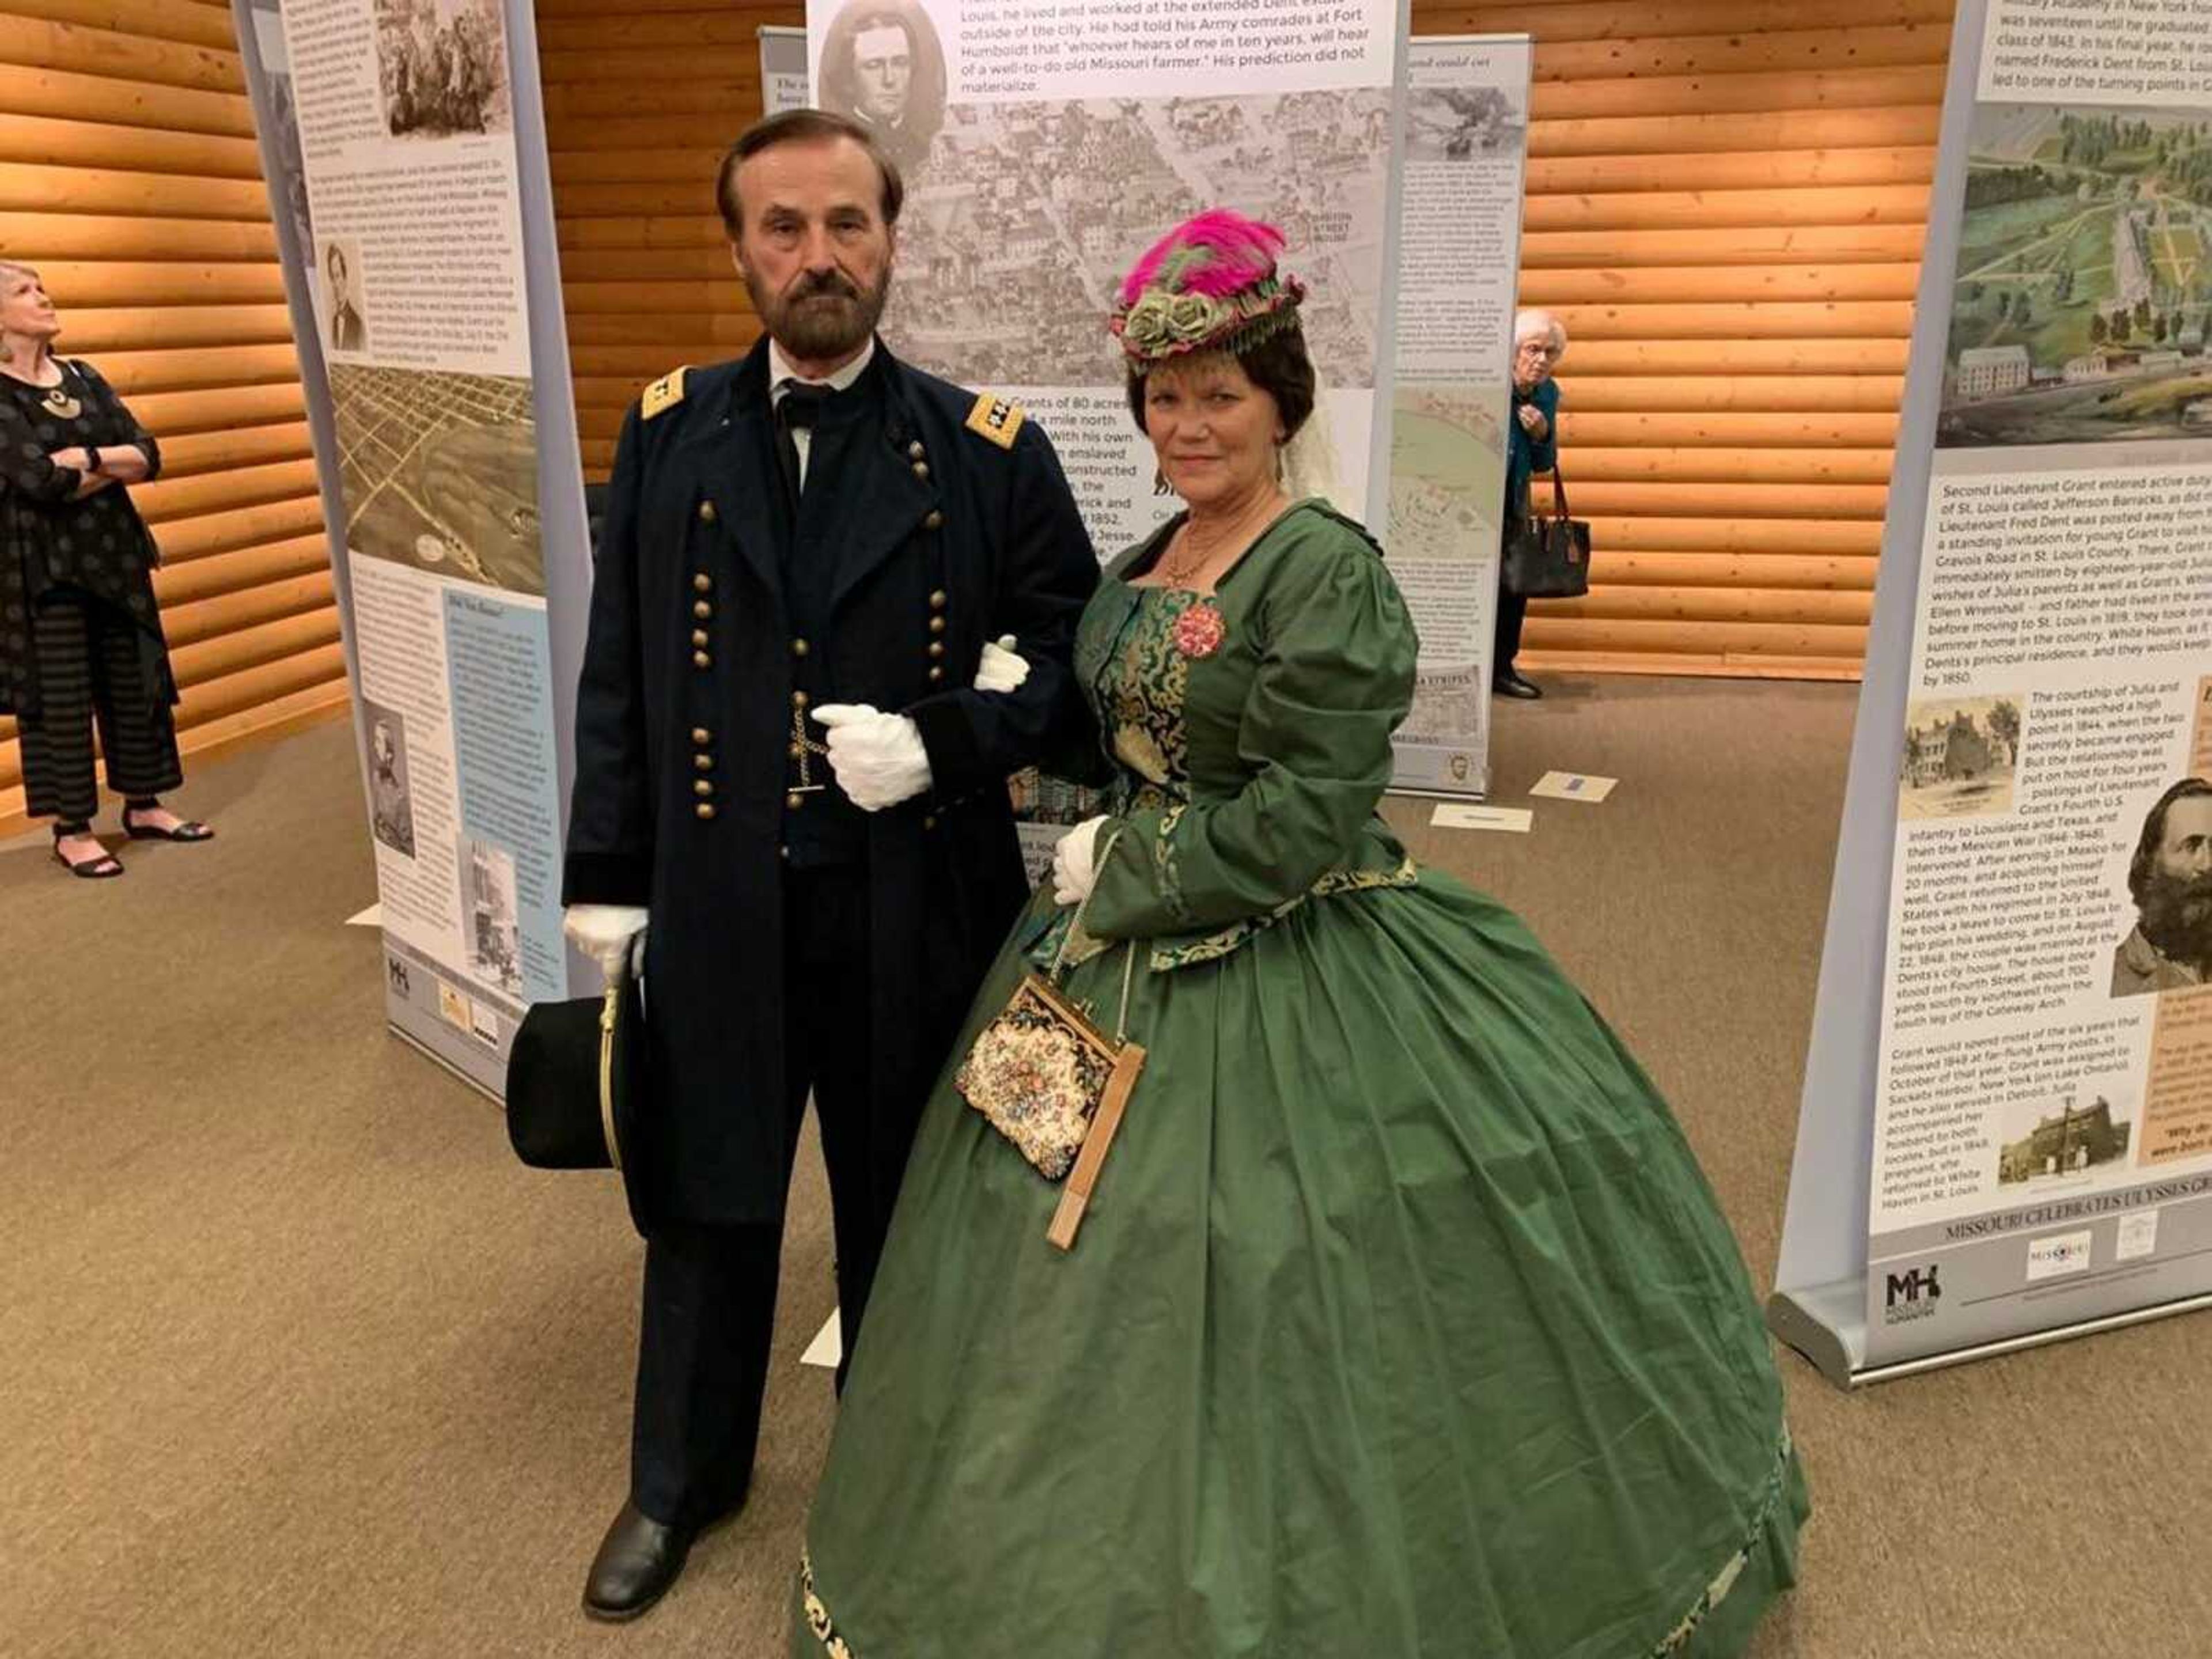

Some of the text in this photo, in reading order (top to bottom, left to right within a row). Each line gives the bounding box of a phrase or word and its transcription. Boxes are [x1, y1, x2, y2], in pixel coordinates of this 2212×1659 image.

[1003, 9, 1020, 20] he
[1024, 6, 1055, 18] lived
[1059, 3, 1084, 17] and
[1089, 1, 1141, 15] worked
[1145, 2, 1160, 13] at
[1164, 0, 1187, 12] the
[1191, 0, 1259, 12] extended
[961, 26, 1011, 40] outside
[1014, 25, 1028, 37] of
[1032, 24, 1054, 36] the
[1090, 21, 1108, 33] He
[1113, 20, 1138, 32] had
[1143, 19, 1171, 32] told
[1176, 18, 1195, 30] his
[1200, 18, 1237, 32] Army
[1241, 14, 1312, 28] comrades
[1316, 13, 1330, 24] at
[1334, 9, 1362, 21] Fort
[2001, 16, 2208, 34] was seventeen until he graduated
[961, 43, 1028, 58] Humboldt
[1033, 43, 1059, 55] that
[1132, 39, 1172, 51] hears
[1175, 37, 1189, 50] of
[1194, 37, 1217, 47] me
[1221, 35, 1234, 47] in
[1238, 34, 1262, 46] ten
[1310, 30, 1334, 43] will
[1338, 28, 1369, 41] hear
[2031, 34, 2044, 47] of
[2096, 36, 2112, 50] his
[2116, 36, 2143, 51] final
[2180, 38, 2195, 52] he
[961, 63, 975, 76] of
[978, 66, 987, 74] a
[989, 60, 1062, 75] well-to-do
[1065, 59, 1087, 71] old
[1090, 57, 1149, 69] Missouri
[1214, 55, 1234, 66] His
[1239, 52, 1311, 68] prediction
[1315, 49, 1338, 61] did
[1341, 47, 1365, 59] not
[1995, 55, 2039, 68] named
[2043, 55, 2099, 69] Frederick
[2104, 56, 2133, 69] Dent
[2137, 56, 2169, 70] from
[961, 81, 1039, 93] materialize.
[1993, 74, 2200, 93] led to one of the turning points in
[1056, 397, 1069, 408] of
[1073, 397, 1089, 409] 80
[1050, 414, 1077, 425] mile
[1081, 415, 1117, 426] north
[1051, 431, 1133, 442] With his own
[1069, 447, 1126, 459] enslaved
[1082, 481, 1104, 491] the
[1943, 486, 1990, 498] Second
[1993, 482, 2059, 495] Lieutenant
[2062, 479, 2096, 491] Grant
[2099, 478, 2146, 490] entered
[2149, 476, 2183, 488] active
[1107, 498, 1132, 509] and
[1941, 503, 1954, 514] of
[1958, 502, 1972, 514] St.
[1978, 501, 2009, 513] Louis
[2013, 498, 2048, 511] called
[2052, 495, 2109, 510] Jefferson
[2168, 493, 2181, 504] as
[2184, 490, 2201, 503] did
[1939, 507, 2203, 532] Lieutenant Fred Dent was posted away from
[1097, 529, 1138, 541] Jesse.
[2006, 526, 2174, 546] invitation for young Grant to
[1936, 554, 1983, 567] Gravois
[1985, 552, 2017, 564] Road
[2020, 551, 2032, 562] in
[2053, 547, 2085, 560] Louis
[2175, 540, 2206, 554] Grant
[2032, 681, 2180, 704] The courtship of Julia and
[2026, 729, 2175, 753] secretly became engaged
[2032, 777, 2160, 800] postings of Lieutenant
[1909, 828, 1956, 842] infantry
[1958, 828, 1971, 838] to
[1974, 821, 2029, 836] Louisiana
[2031, 819, 2055, 832] and
[2094, 813, 2118, 824] and
[1945, 1214, 2024, 1240] MISSOURI
[2026, 1193, 2121, 1224] CELEBRATES
[2124, 1180, 2188, 1207] ULYSSES
